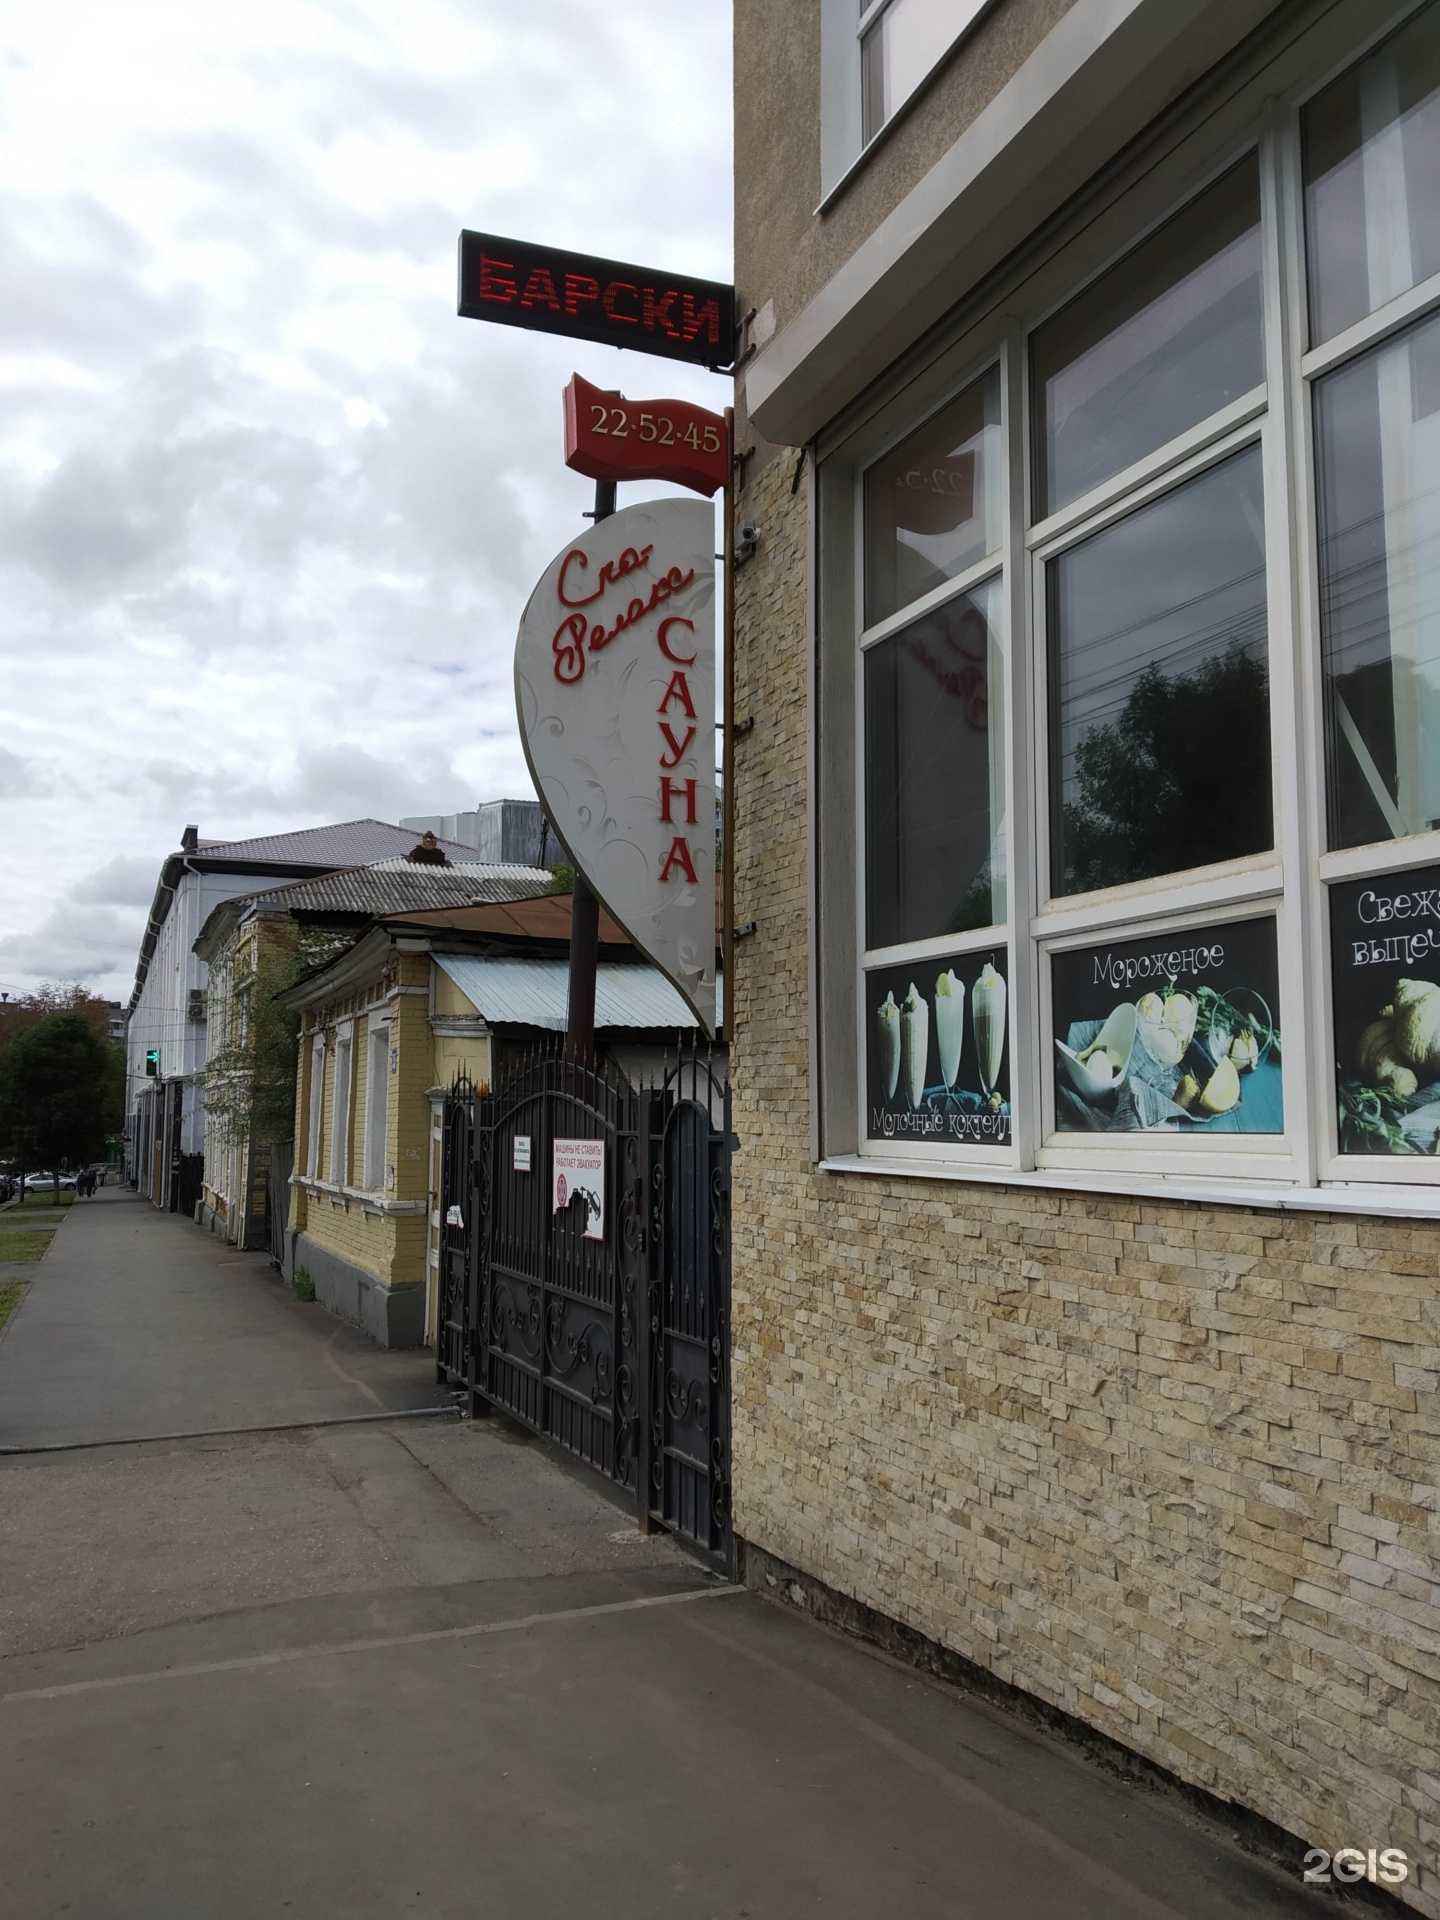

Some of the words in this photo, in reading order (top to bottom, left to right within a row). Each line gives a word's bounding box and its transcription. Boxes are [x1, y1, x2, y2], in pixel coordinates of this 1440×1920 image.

[479, 252, 720, 345] БАРСКИ
[656, 616, 699, 883] САУНА
[1358, 889, 1440, 924] Свеж
[1093, 944, 1225, 989] Мороженое
[873, 1105, 943, 1136] Молочные
